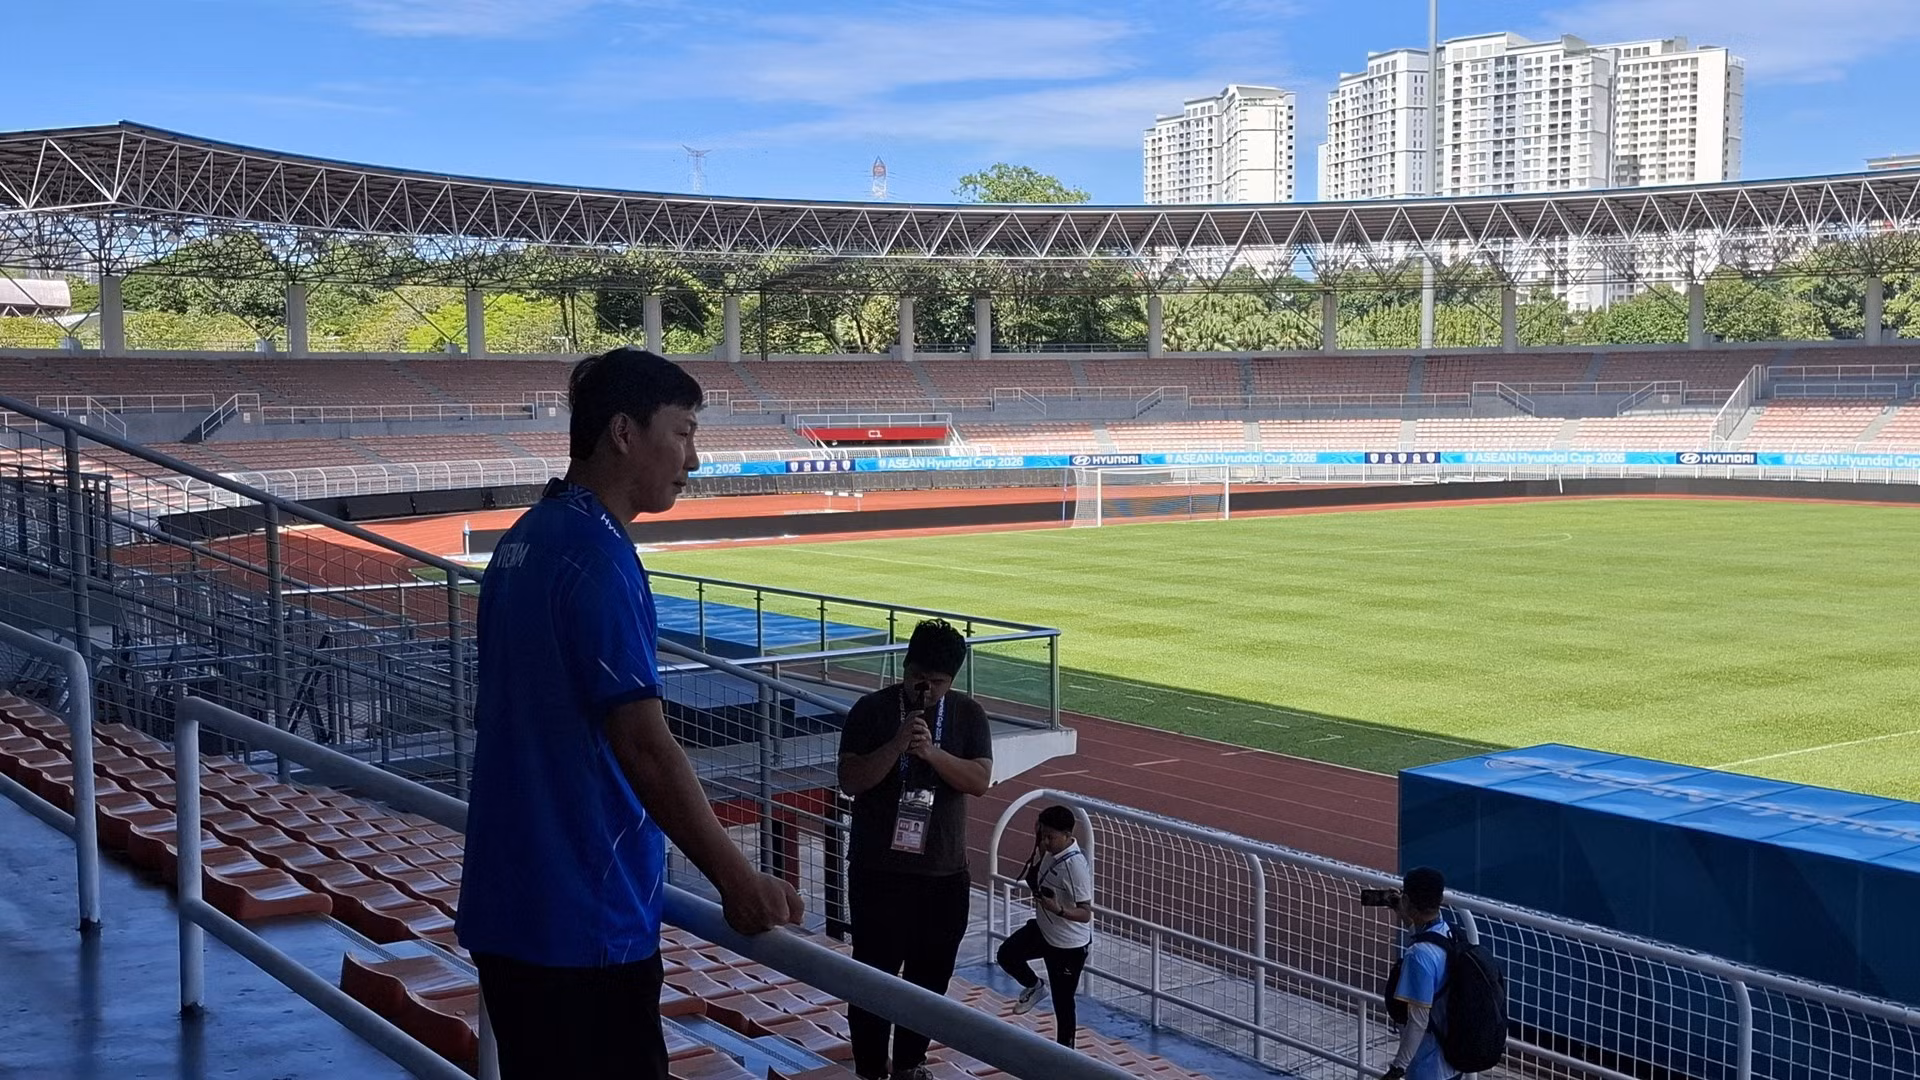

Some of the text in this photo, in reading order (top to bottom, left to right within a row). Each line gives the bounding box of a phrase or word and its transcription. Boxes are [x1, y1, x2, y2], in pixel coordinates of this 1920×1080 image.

[887, 457, 1024, 470] ASEAN Hyundai Cup 2026
[1092, 455, 1139, 465] HYUNDAI
[1174, 453, 1317, 465] ASEAN Hyundai Cup 2026
[1475, 452, 1626, 465] ASEAN Hyundai Cup 2026
[1702, 454, 1755, 464] HYUNDAI
[1794, 454, 1920, 469] ASEAN Hyundai Cup
[715, 463, 742, 474] 2026
